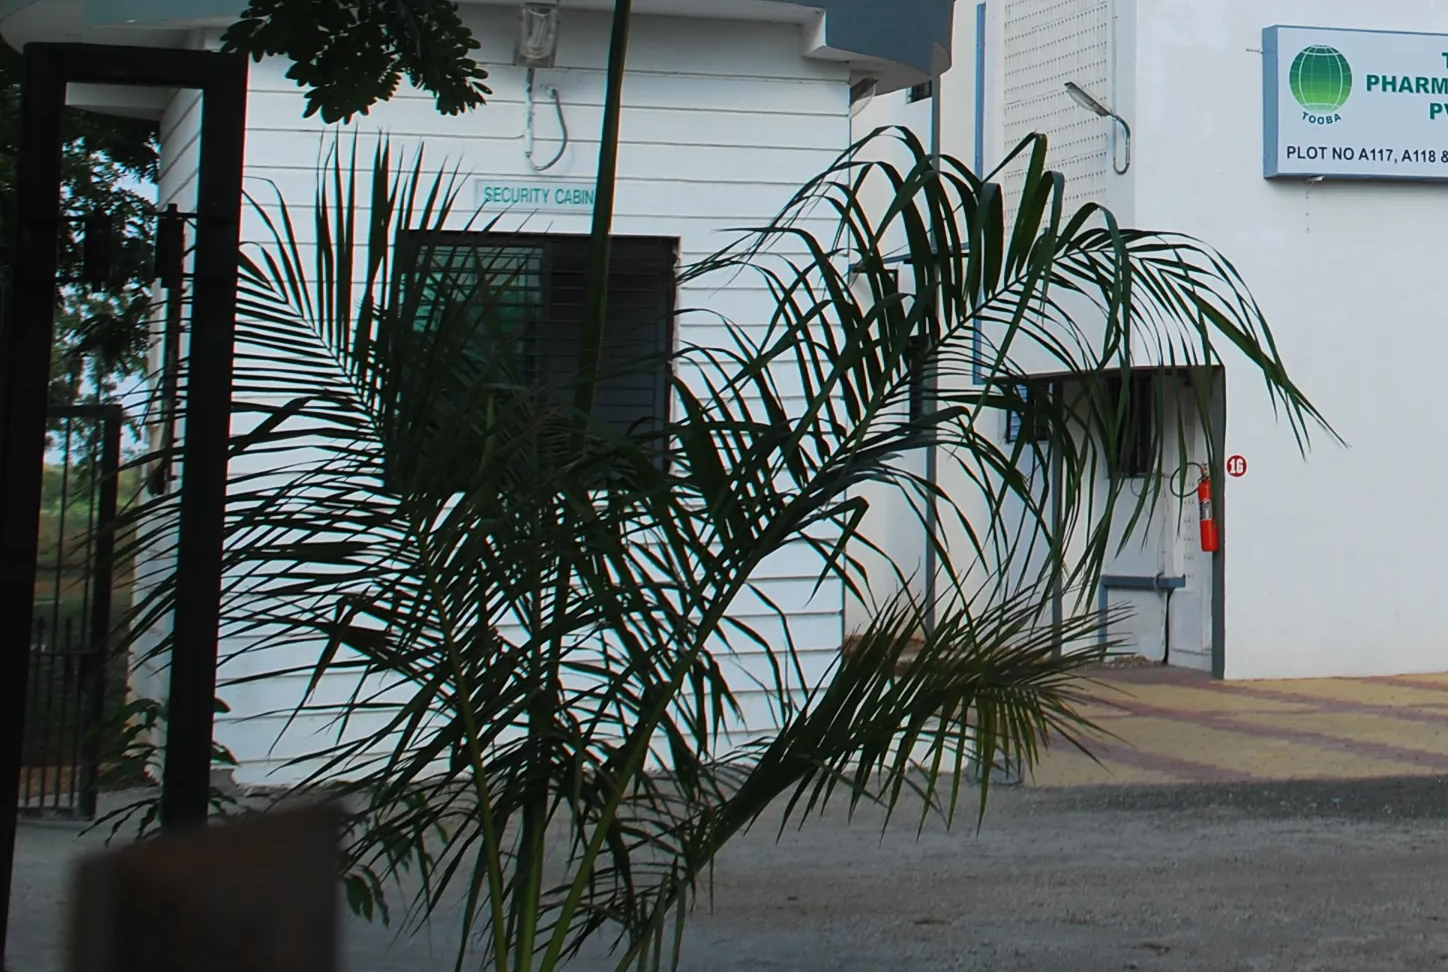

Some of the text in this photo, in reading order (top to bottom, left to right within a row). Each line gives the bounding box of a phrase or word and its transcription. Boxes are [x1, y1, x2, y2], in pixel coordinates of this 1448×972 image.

[1301, 111, 1342, 125] TOOBA
[1286, 145, 1327, 160] PLOT
[1332, 147, 1355, 161] NO
[1358, 148, 1398, 164] A117,
[1401, 149, 1436, 163] A118
[484, 186, 594, 205] SECURITY CABIN
[1228, 457, 1244, 475] 16
